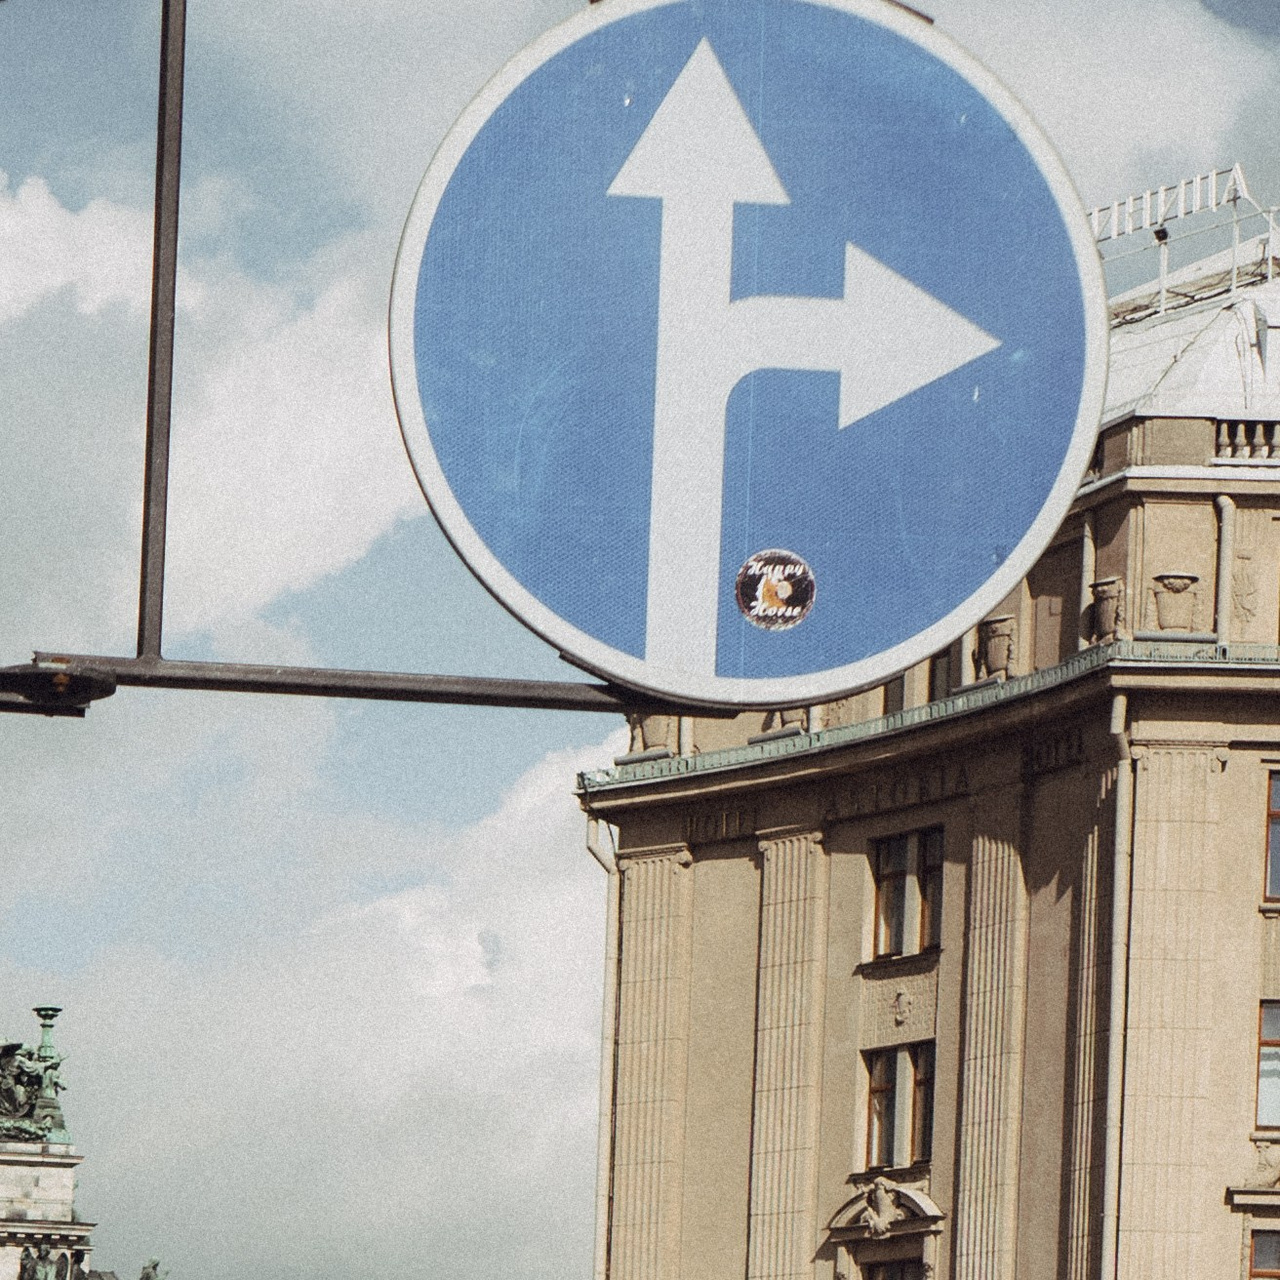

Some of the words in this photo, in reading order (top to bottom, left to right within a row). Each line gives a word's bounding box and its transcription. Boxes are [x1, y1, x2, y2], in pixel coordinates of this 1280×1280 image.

[1092, 162, 1251, 241] ИНИЦА
[747, 561, 806, 583] Happy
[749, 600, 802, 617] Horse
